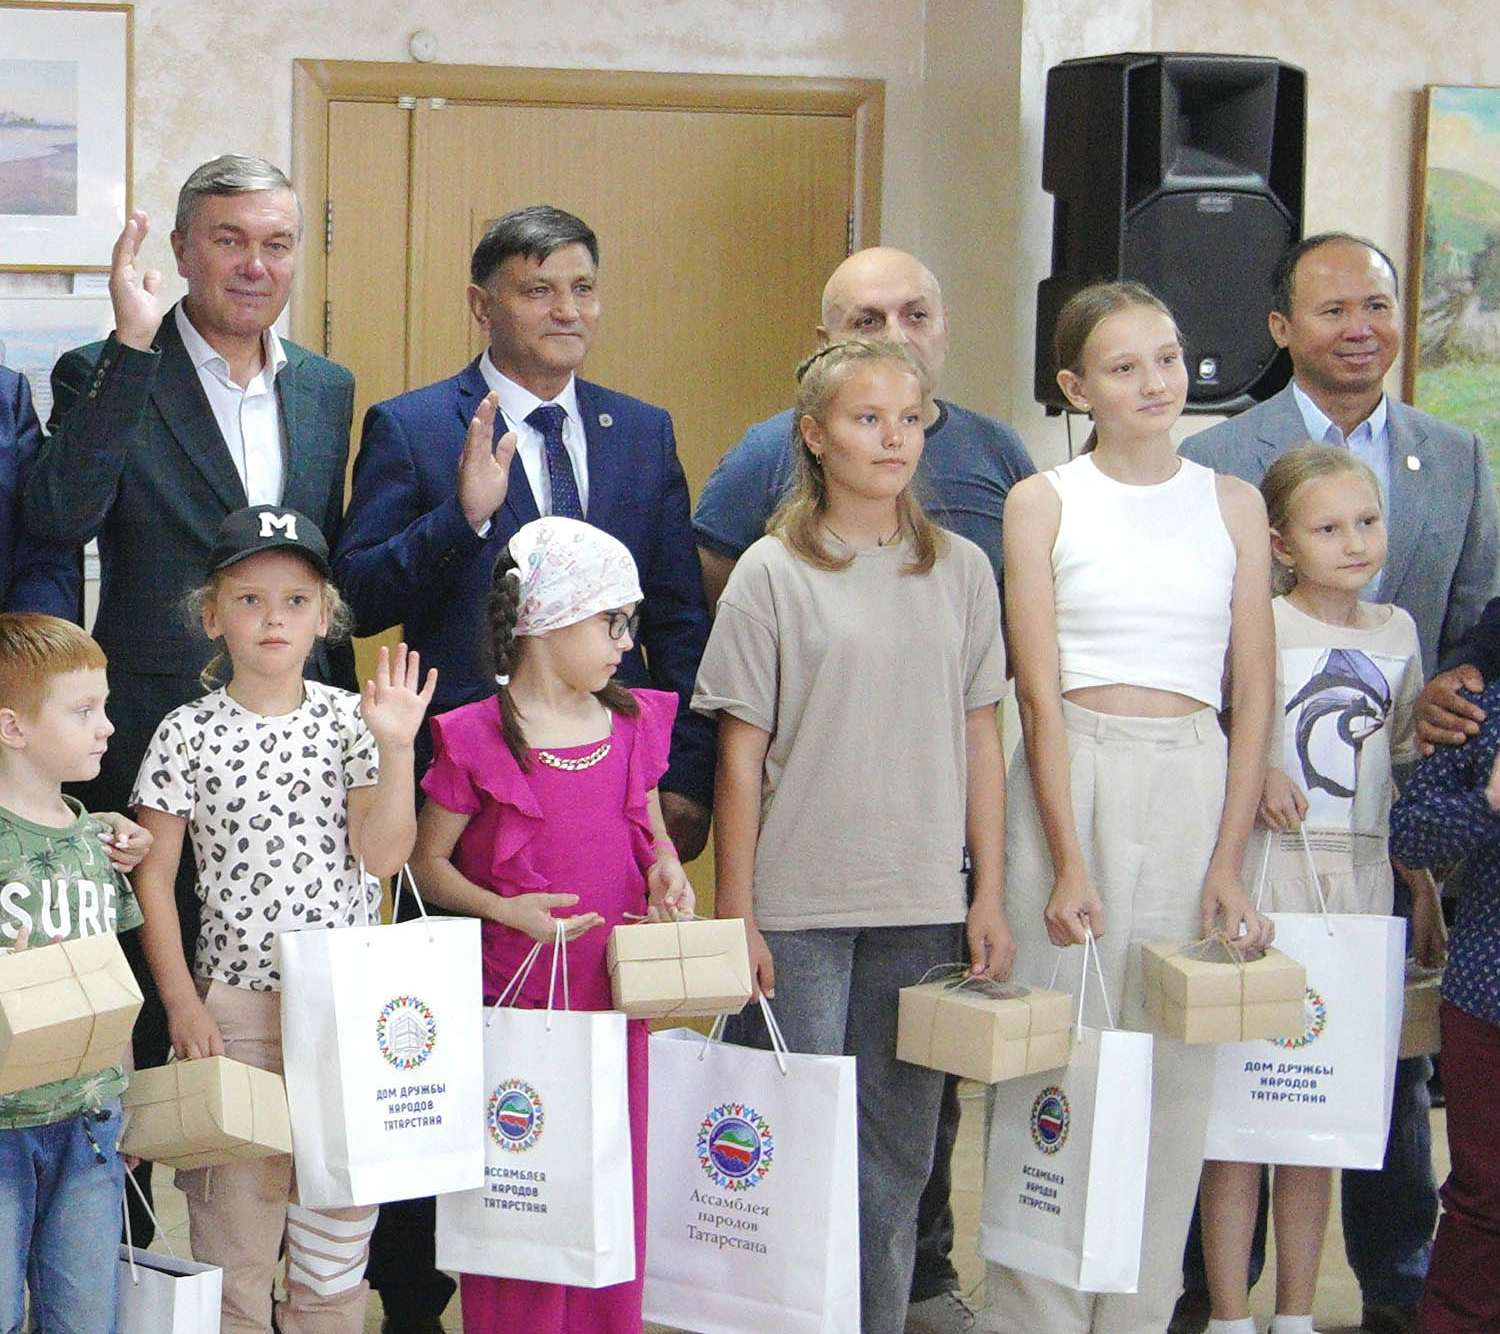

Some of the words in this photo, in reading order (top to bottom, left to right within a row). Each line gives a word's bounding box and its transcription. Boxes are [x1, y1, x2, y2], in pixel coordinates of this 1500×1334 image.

[259, 512, 298, 540] M
[1244, 1061, 1273, 1072] ДОМ
[1277, 1063, 1334, 1075] ДРУЖБЫ
[1260, 1076, 1317, 1089] НАРОДОВ
[376, 1088, 397, 1101] ДОМ
[400, 1082, 446, 1098] ДРУЖБЫ
[1250, 1090, 1326, 1103] ТАТАРСТАНА
[388, 1100, 434, 1114] НАРОДОВ
[384, 1115, 442, 1131] ТАТАРСТАНА
[484, 1166, 546, 1182] АССАМБЛЕЯ
[491, 1183, 538, 1198] НАРОДОВ
[483, 1197, 547, 1213] ТАТАРСТАНА
[689, 1188, 770, 1216] Ассамблея
[697, 1211, 759, 1232] народов
[686, 1224, 767, 1254] Татарстана
